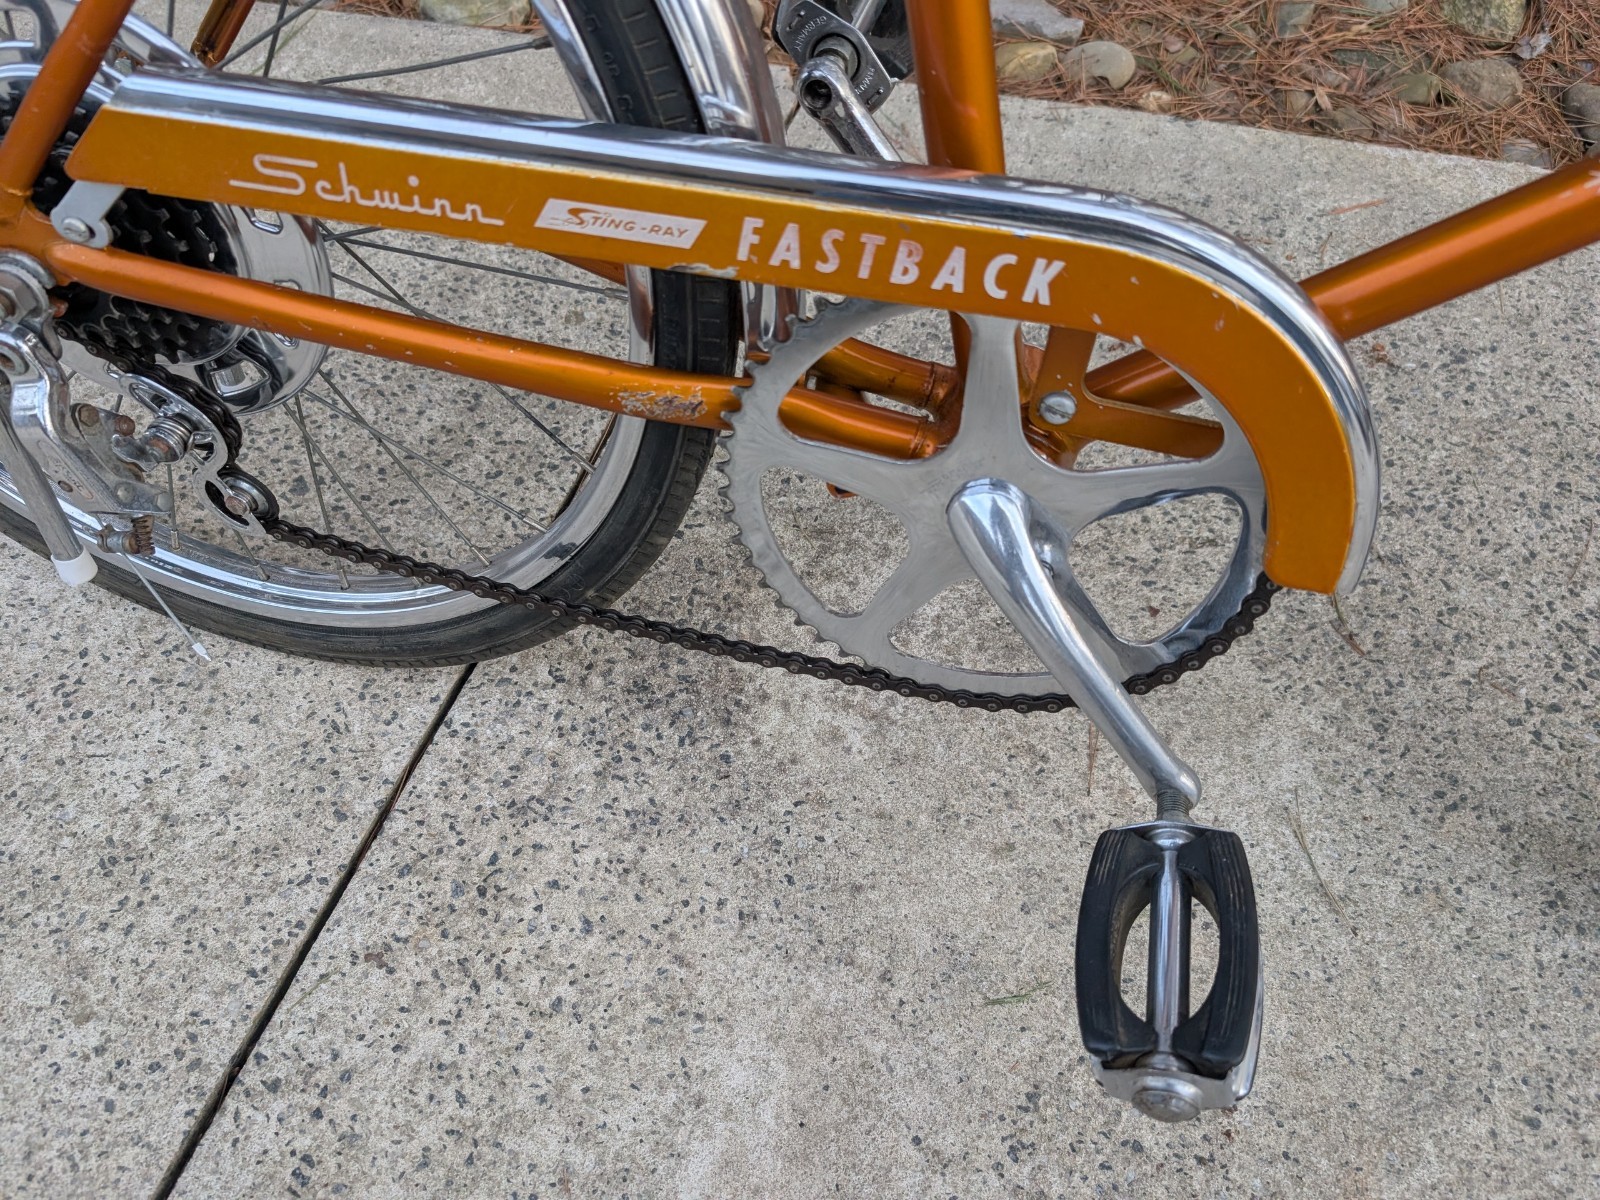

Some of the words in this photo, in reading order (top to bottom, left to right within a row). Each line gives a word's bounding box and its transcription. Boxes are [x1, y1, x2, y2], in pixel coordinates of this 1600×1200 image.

[793, 14, 828, 53] GERMANY
[228, 153, 505, 227] Schwinn
[566, 206, 690, 239] STING-RAY
[736, 216, 1066, 306] FASTBACK
